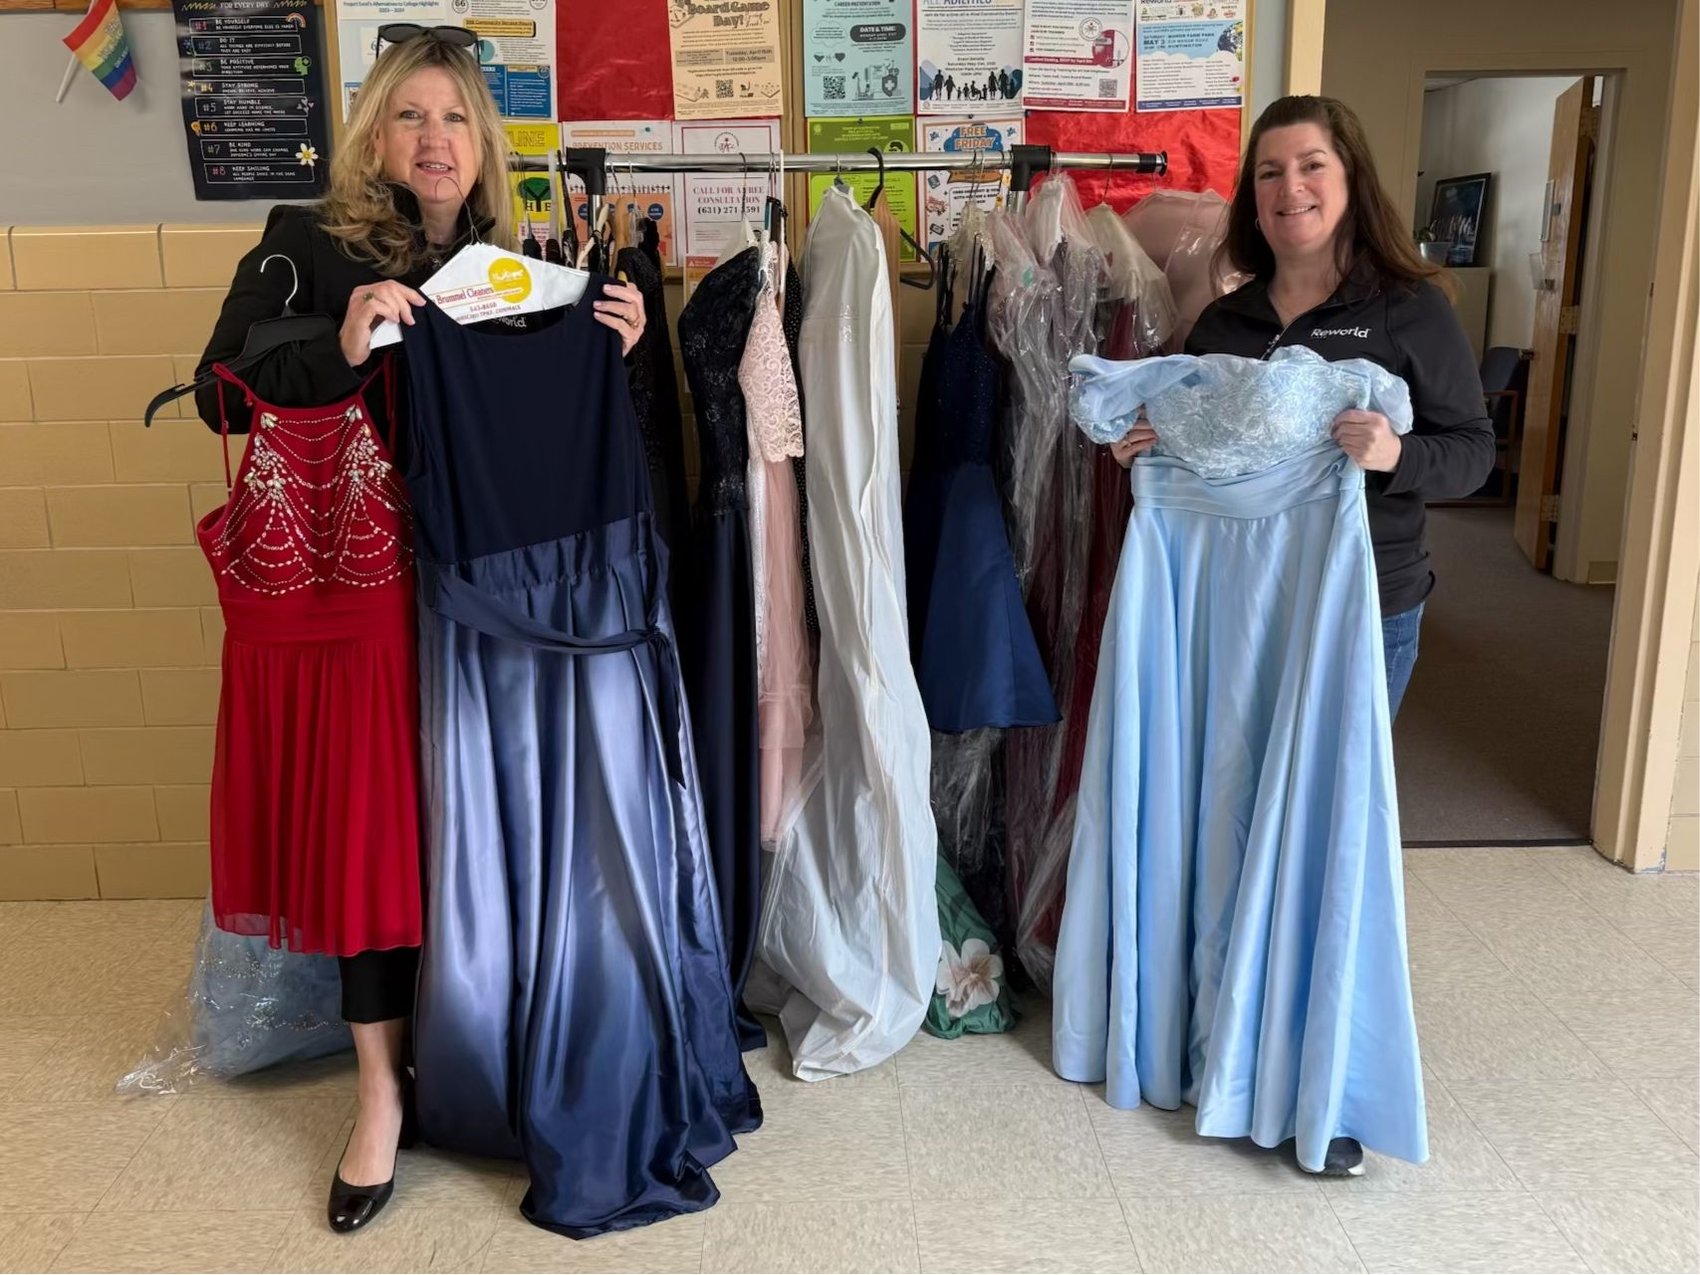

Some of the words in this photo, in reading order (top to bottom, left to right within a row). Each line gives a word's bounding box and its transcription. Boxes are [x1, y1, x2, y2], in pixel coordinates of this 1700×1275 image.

[688, 2, 730, 14] Board
[731, 1, 770, 13] Game
[713, 15, 744, 28] Day!
[203, 102, 217, 112] #5
[204, 122, 218, 131] #6
[960, 126, 988, 136] FREE
[624, 142, 663, 150] SERVICES
[954, 138, 994, 148] FRIDAY
[208, 144, 220, 154] #7
[212, 166, 225, 175] #8
[698, 206, 721, 215] (631)
[436, 292, 466, 305] Brummel
[467, 286, 493, 299] Cleaners
[1311, 326, 1369, 338] Reworld
